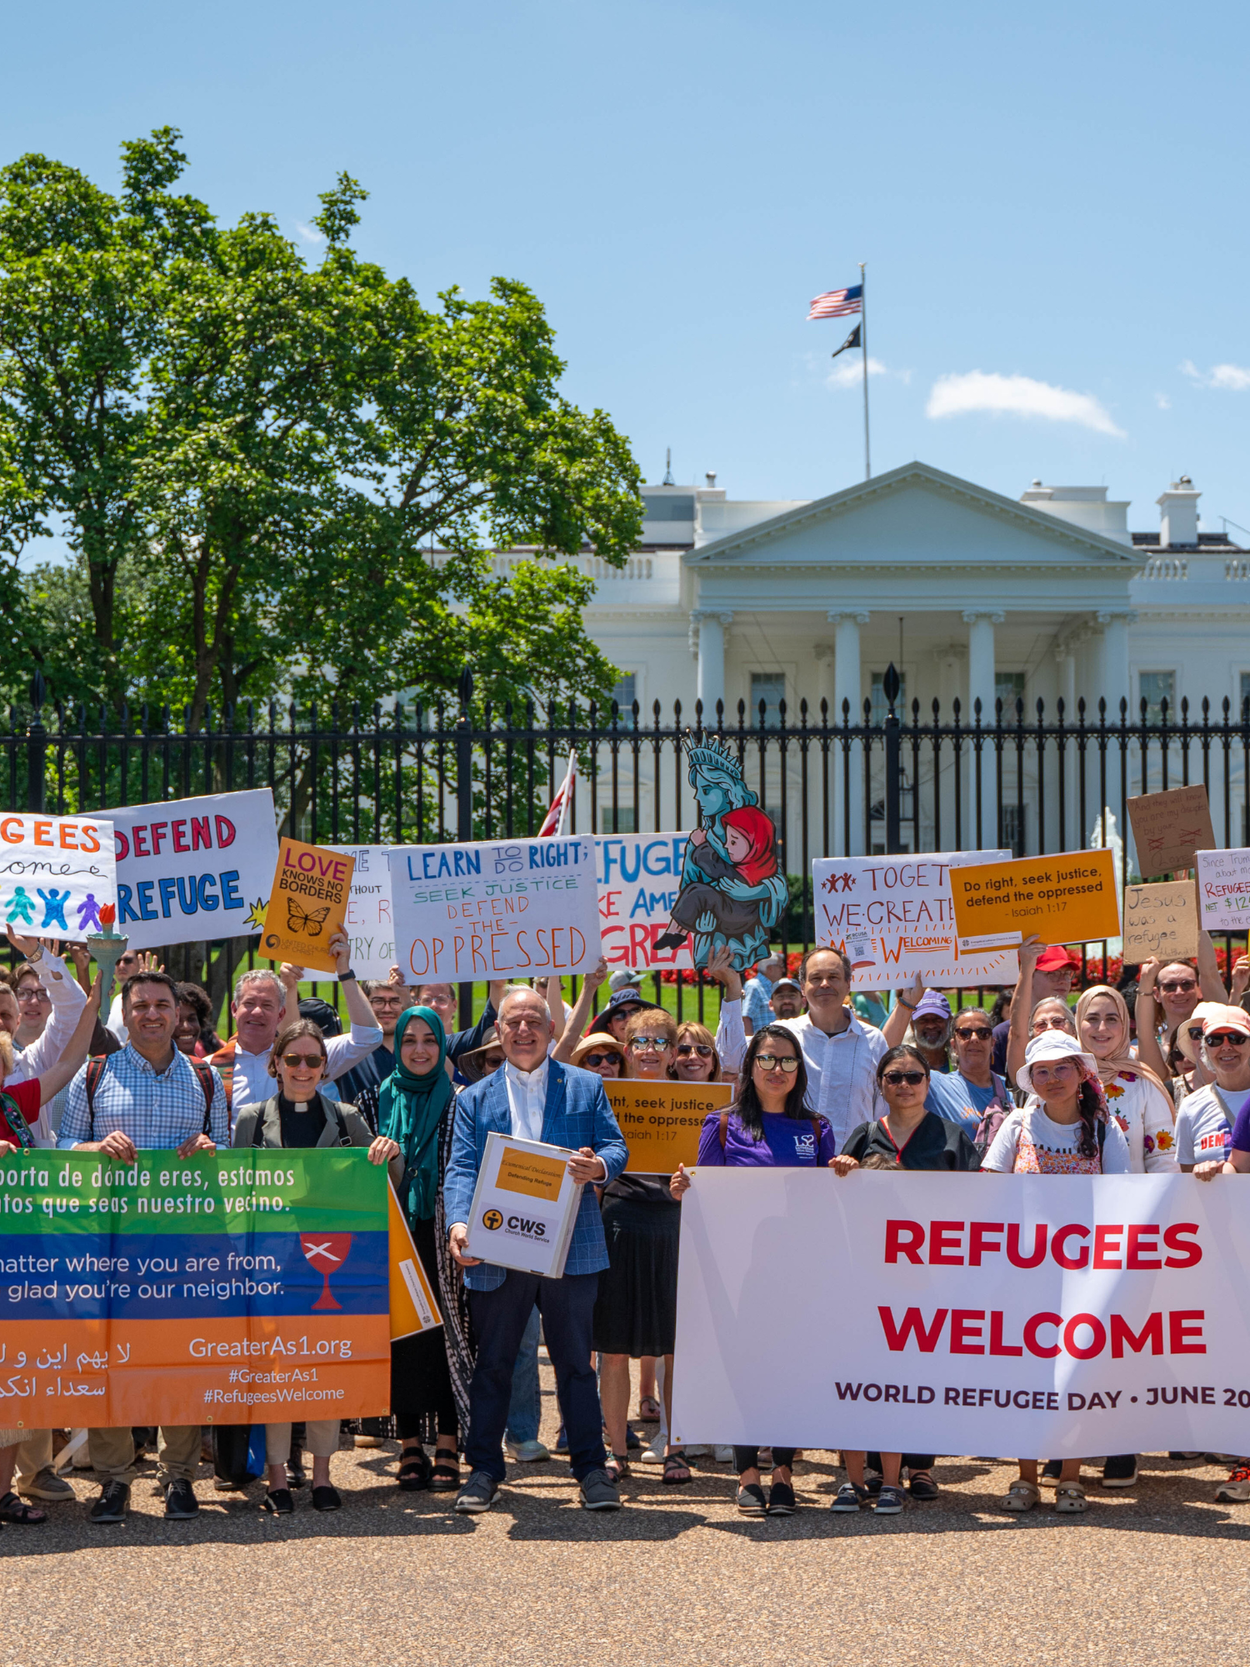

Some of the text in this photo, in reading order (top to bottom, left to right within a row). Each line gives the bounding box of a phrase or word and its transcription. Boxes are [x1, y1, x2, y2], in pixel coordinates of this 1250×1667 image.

[0, 817, 101, 853] GEES
[114, 814, 237, 862] DEFEND
[491, 845, 522, 859] TO
[1202, 857, 1225, 868] Since
[284, 847, 348, 882] LOVE
[407, 849, 481, 882] LEARN
[495, 860, 524, 875] DO
[1215, 868, 1237, 878] about
[282, 868, 343, 892] KNOWS NO
[862, 863, 950, 891] TOGET
[964, 867, 1102, 893] Do right, seek justice,
[117, 870, 245, 925] REFUGE
[279, 878, 342, 904] BORDERS
[413, 877, 579, 904] SEEK JUSTICE
[966, 881, 1103, 908] defend the oppressed
[1128, 888, 1186, 910] Jesus
[447, 895, 530, 920] DEFEND
[1011, 902, 1067, 918] Isaiah 1:17
[1205, 902, 1218, 911] NET
[1129, 914, 1177, 927] was a
[1231, 915, 1243, 925] the
[379, 942, 395, 960] OF
[410, 926, 586, 976] OPPRESSED
[601, 923, 695, 968] GREA
[880, 936, 953, 964] WELCOMING
[1127, 929, 1178, 952] refugee
[635, 1098, 666, 1109] seek
[624, 1112, 645, 1124] the
[656, 1130, 677, 1141] 1:17
[58, 1163, 295, 1191] de dónde eres, estamos
[534, 1177, 552, 1187] Refuge
[42, 1191, 290, 1218] que seas nuestro vecino.
[505, 1228, 520, 1236] Church
[521, 1232, 534, 1240] World
[507, 1216, 546, 1236] CWS
[884, 1219, 1203, 1271] REFUGEES
[66, 1252, 282, 1275] where you are from,
[8, 1278, 285, 1303] glad our neighbor.
[877, 1305, 1207, 1359] WELCOME
[117, 1342, 131, 1364] لا
[188, 1335, 353, 1359] GreaterAs1.org
[76, 1350, 109, 1374] يهم
[46, 1376, 106, 1397] سعداء
[228, 1368, 319, 1384] #GreaterAs1
[204, 1386, 345, 1406] #RefugeesWelcome
[835, 1381, 936, 1405] WORLD
[944, 1386, 1061, 1411] REFUGEE
[1067, 1389, 1122, 1412] DAY
[1145, 1386, 1216, 1407] JUNE
